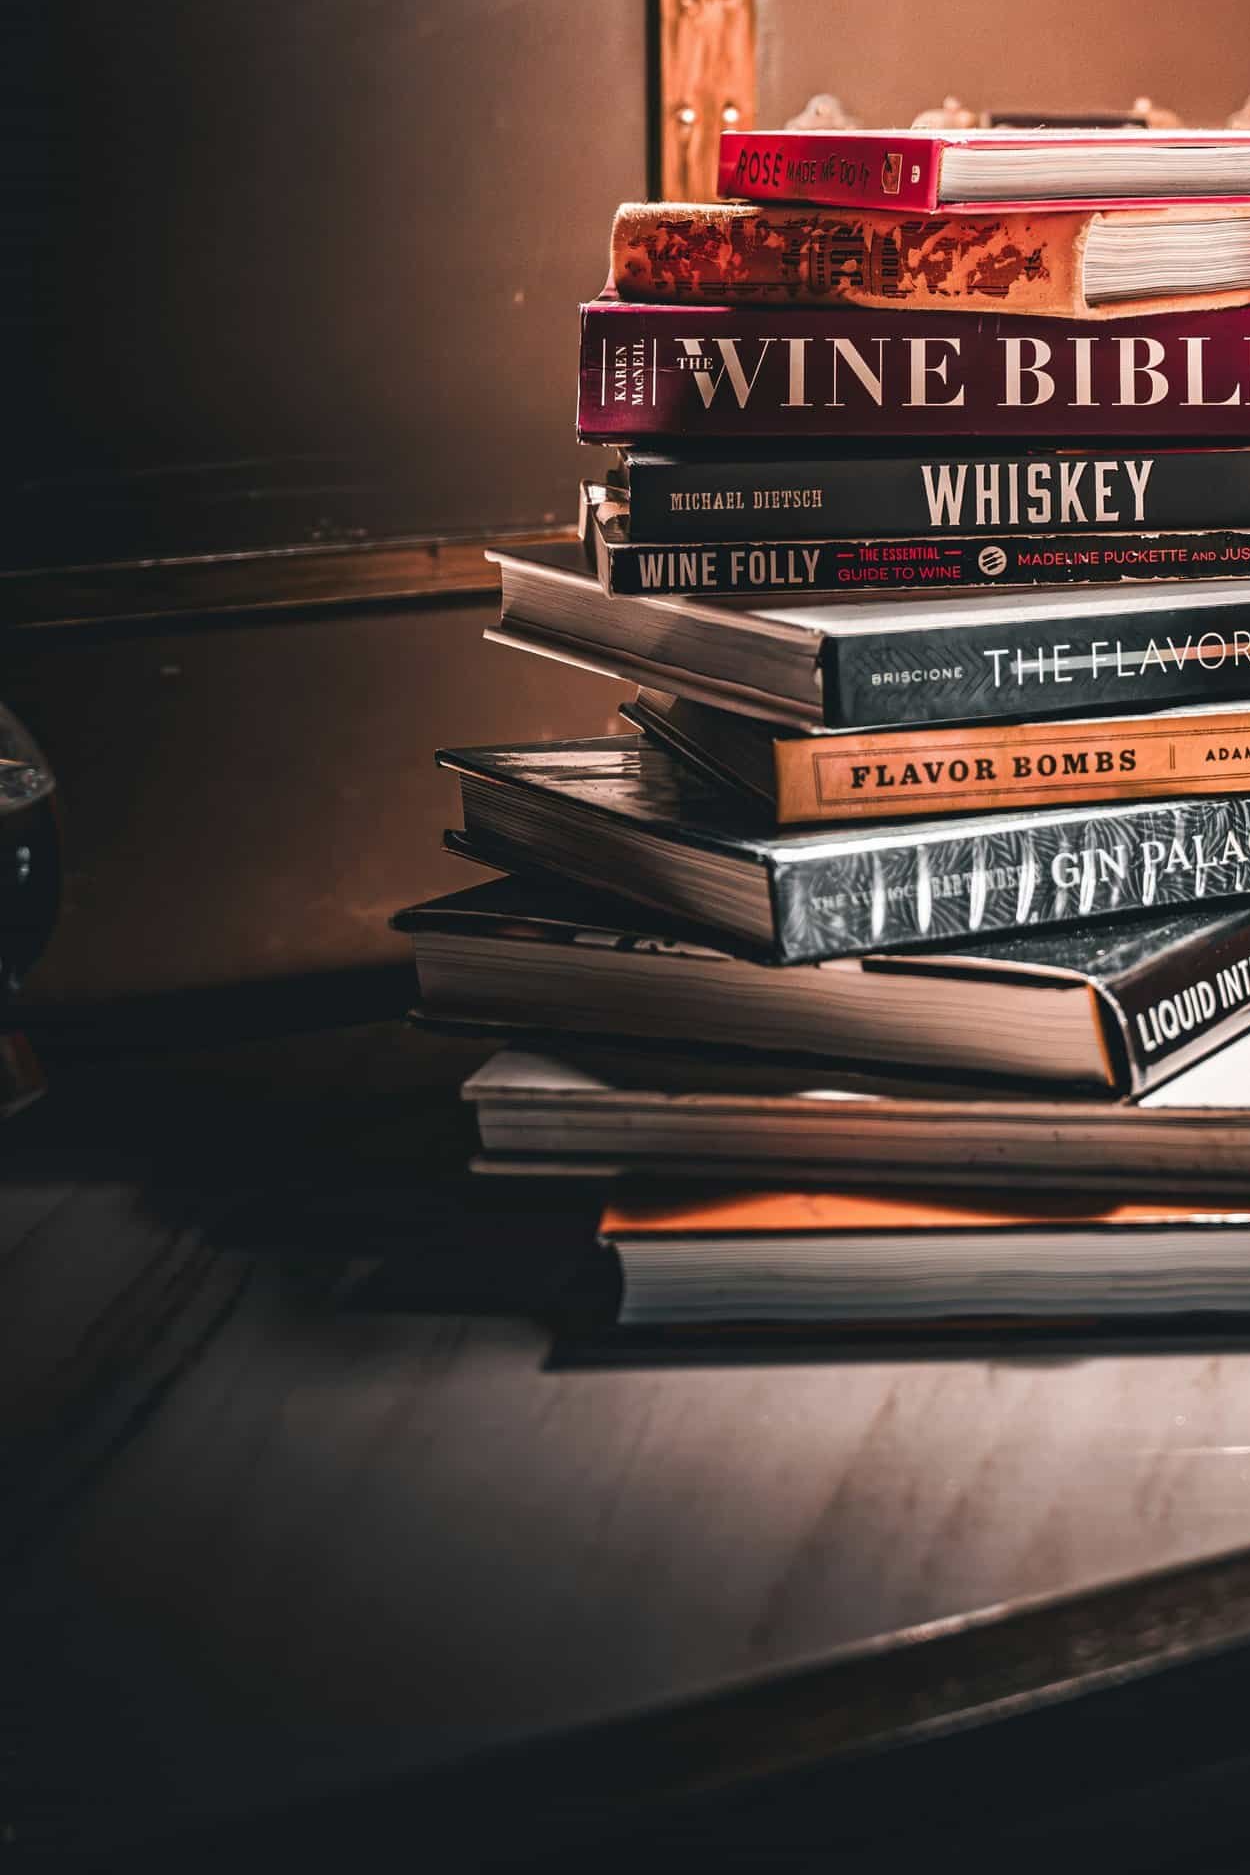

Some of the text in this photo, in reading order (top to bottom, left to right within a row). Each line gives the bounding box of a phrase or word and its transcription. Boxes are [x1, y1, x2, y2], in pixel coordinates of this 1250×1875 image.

[614, 346, 628, 402] KAREN
[674, 338, 965, 409] WINE
[676, 357, 714, 370] THE
[670, 490, 824, 511] MICHAEL DIETSCH
[921, 460, 1155, 526] WHISKEY
[638, 549, 820, 589] WINE FOLLY
[837, 565, 961, 582] GUIDE TO WINE
[859, 547, 941, 561] THE ESSENTIAL
[1017, 548, 1099, 566] MADELINE
[1104, 548, 1187, 565] PUCKETTE
[1191, 549, 1217, 561] AND
[871, 666, 963, 685] BRISCIONE
[984, 644, 1073, 688] THE
[851, 749, 1137, 789] FLAVOR BOMBS
[1051, 845, 1127, 888] GIN
[1136, 980, 1218, 1053] LIQUID
